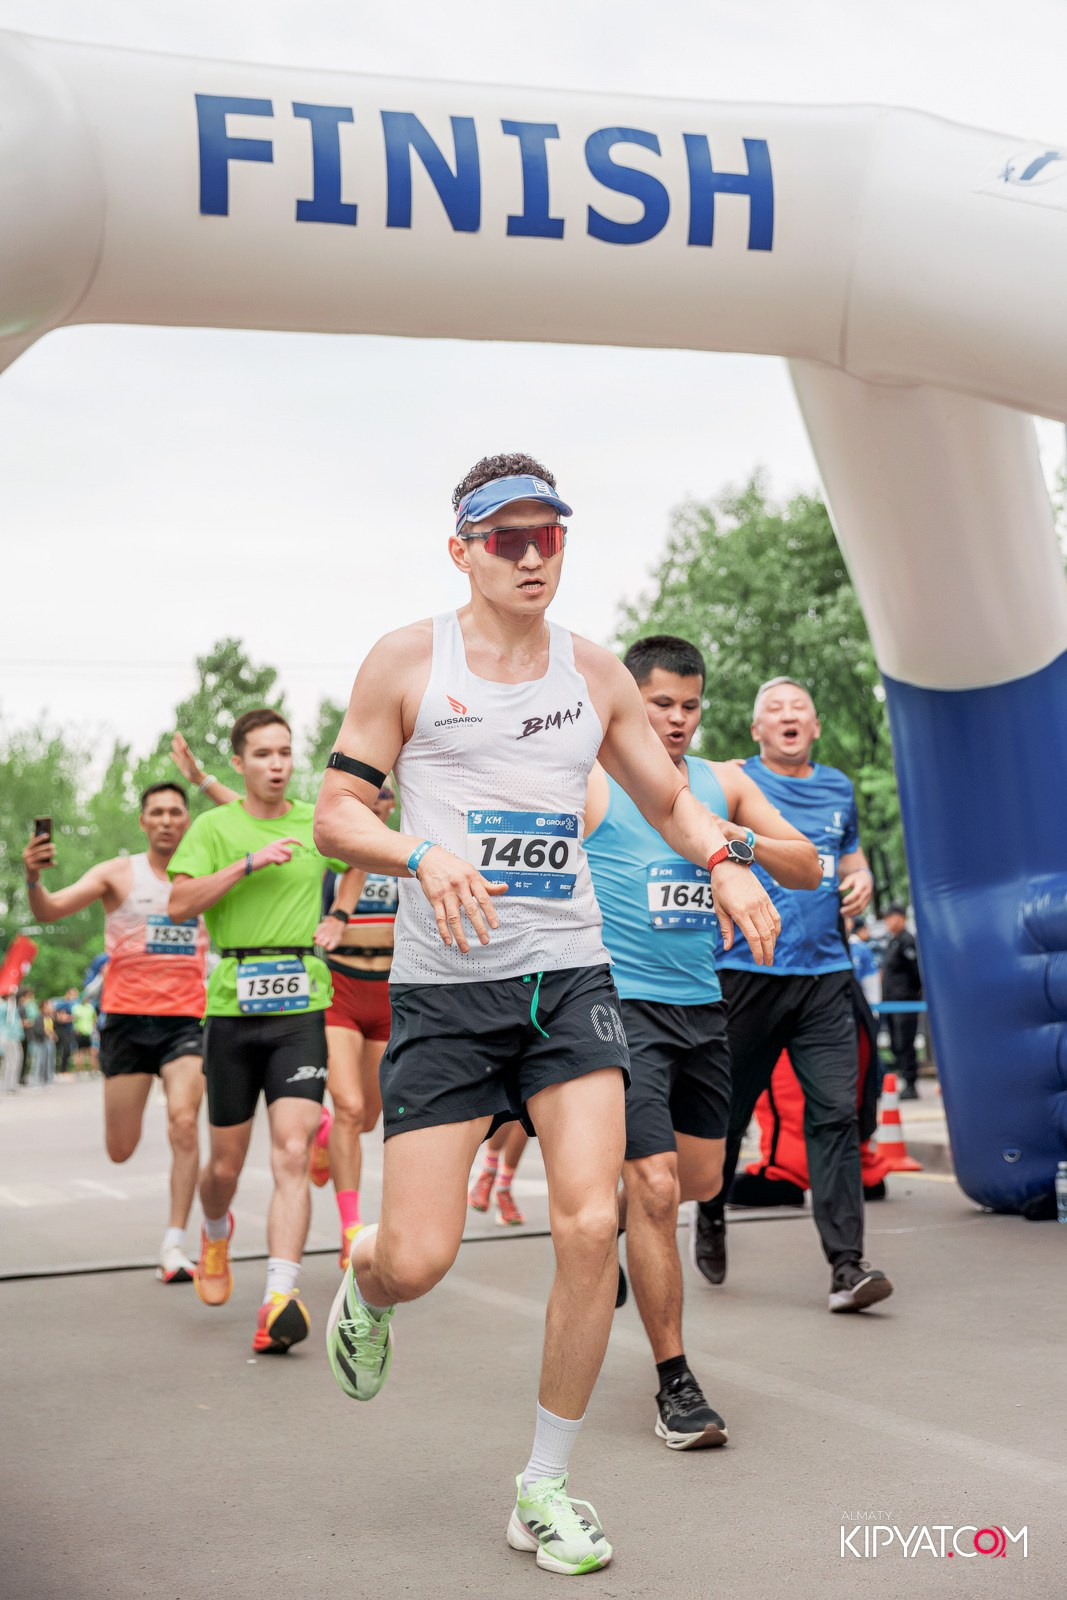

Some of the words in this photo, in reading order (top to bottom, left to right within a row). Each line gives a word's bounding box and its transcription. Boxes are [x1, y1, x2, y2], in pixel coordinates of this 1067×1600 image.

[195, 93, 774, 252] FINISH
[434, 716, 484, 727] GUSSAROV
[472, 813, 483, 824] 5
[484, 815, 502, 825] KM
[480, 837, 569, 870] 1460
[650, 867, 658, 876] 5
[659, 868, 673, 876] KM
[364, 884, 390, 898] 66
[660, 884, 714, 909] 1643
[153, 927, 194, 943] 1520
[247, 976, 300, 997] 1366
